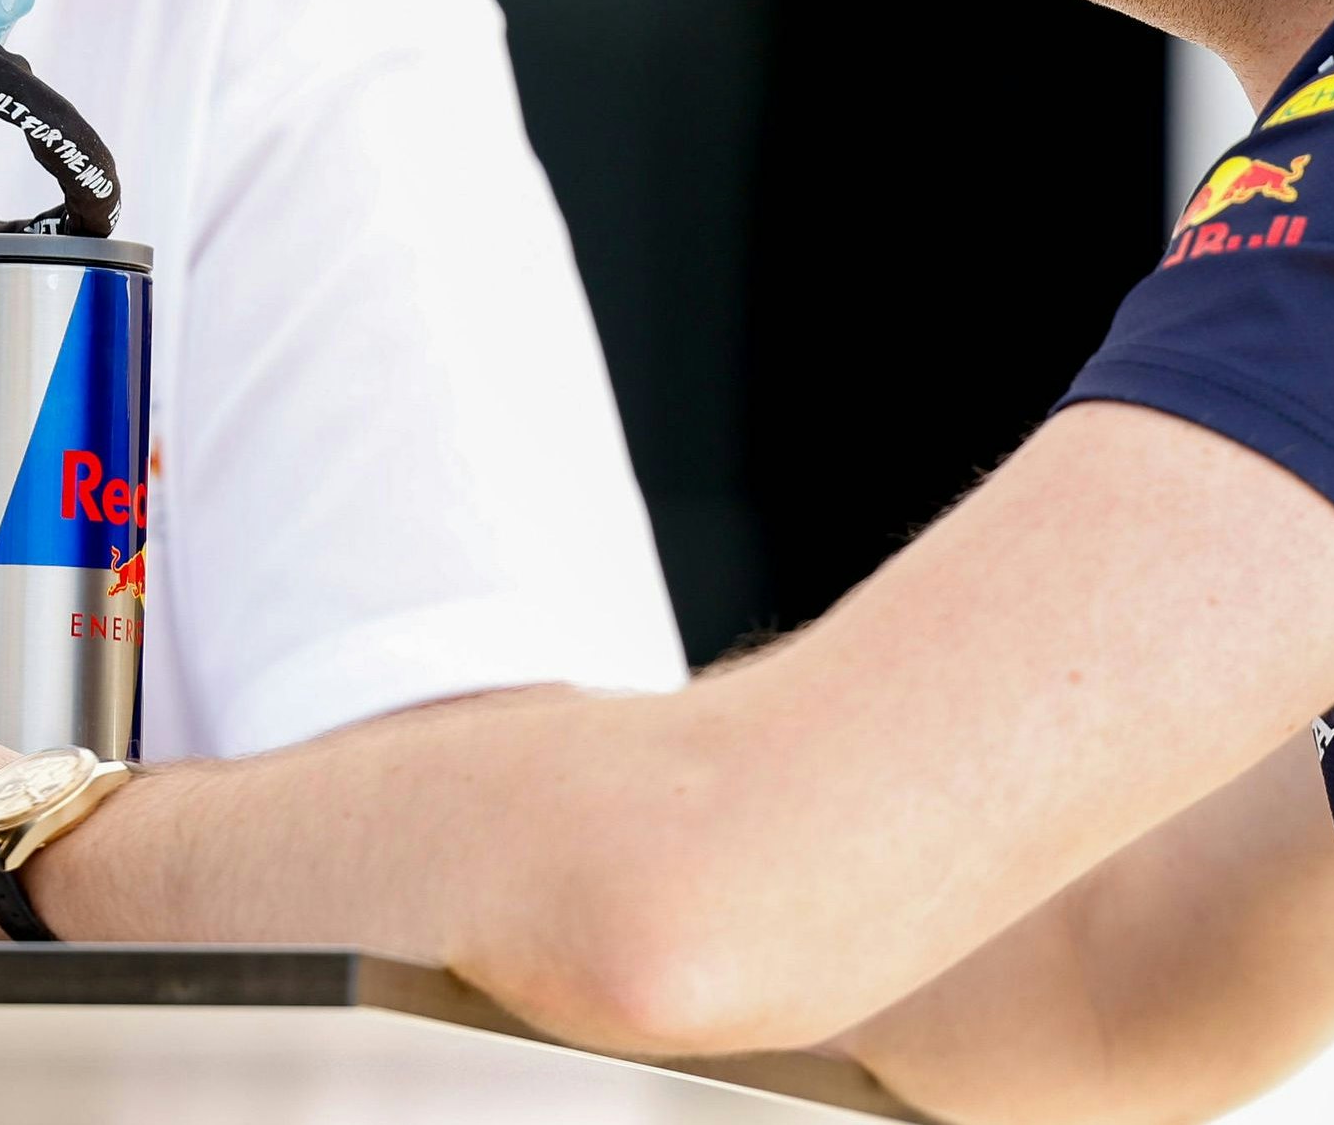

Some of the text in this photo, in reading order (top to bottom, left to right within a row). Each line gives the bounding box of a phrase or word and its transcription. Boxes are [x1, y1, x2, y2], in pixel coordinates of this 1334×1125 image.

[20, 115, 63, 148] FOR
[54, 139, 89, 173] THE
[70, 612, 144, 646] ENERG
